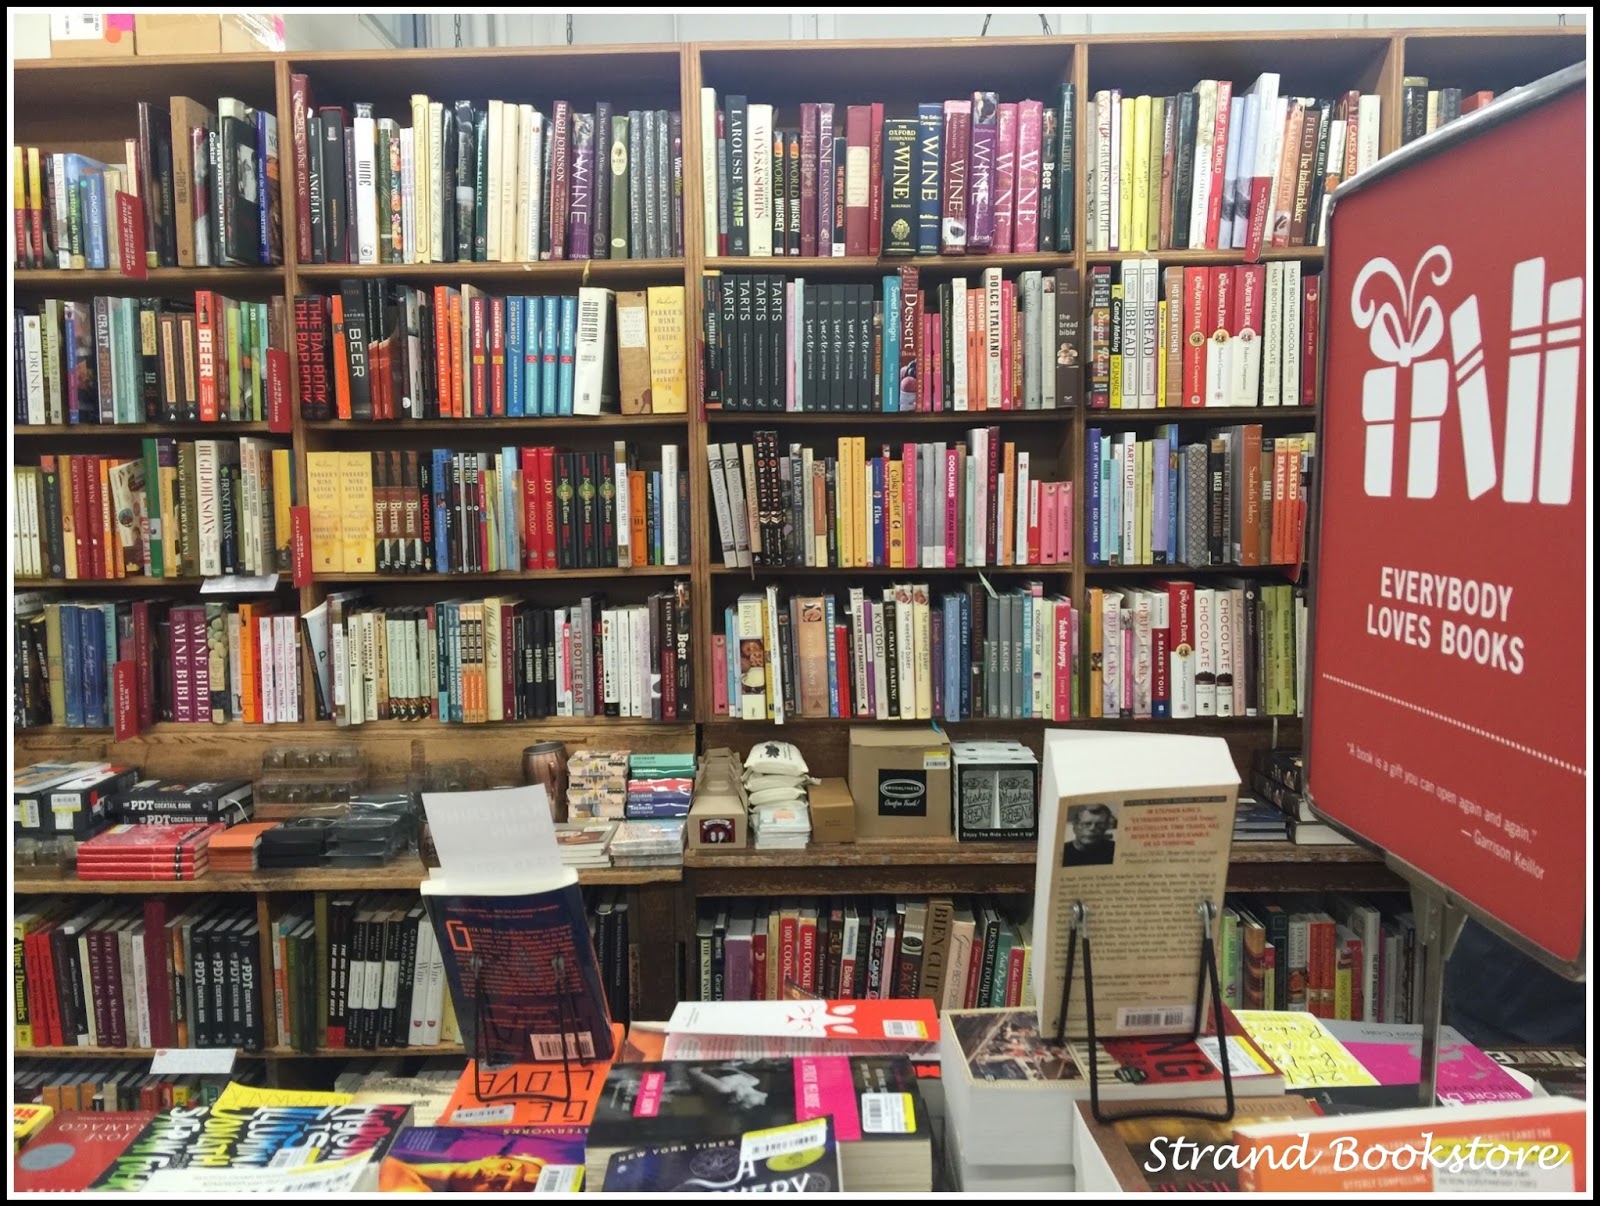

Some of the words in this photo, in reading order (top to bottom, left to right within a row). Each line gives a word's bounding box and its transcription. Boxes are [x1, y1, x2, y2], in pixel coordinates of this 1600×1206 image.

[731, 110, 743, 184] LAROUSSE
[1305, 117, 1315, 148] FIELD
[1349, 125, 1358, 152] CAKES
[774, 159, 783, 196] WORLD
[789, 159, 799, 197] WORLD
[893, 146, 910, 199] WINE
[921, 136, 940, 201] WINE
[971, 138, 990, 205] WINE
[1042, 162, 1055, 189] Beer
[1348, 154, 1357, 174] AND
[571, 156, 588, 224] WINE
[949, 160, 964, 212] WINE
[994, 152, 1014, 226] WINE
[1017, 151, 1038, 226] WINE
[733, 188, 743, 227] WINE
[774, 198, 785, 232] WHISKEY
[790, 199, 800, 233] WHISKEY
[1098, 200, 1109, 232] RALPH
[1295, 198, 1308, 222] Baker
[123, 227, 132, 271] OVERSIZE
[126, 204, 136, 266] BEER/SPIRITS
[724, 280, 735, 321] TARTS
[740, 280, 750, 321] TARTS
[756, 280, 766, 321] TARTS
[772, 281, 782, 321] TARTS
[889, 287, 900, 310] Sweet
[990, 275, 999, 307] DOLCE
[97, 314, 109, 348] CRAFT
[309, 301, 322, 330] THE
[581, 302, 599, 343] BORDEAUX
[888, 311, 899, 342] Designs
[904, 293, 917, 349] Dessert
[990, 310, 999, 358] ITALIANO
[1094, 311, 1109, 344] Sugar
[1125, 309, 1136, 356] BREAD
[1143, 309, 1155, 356] BREAD
[199, 329, 212, 377] BEER
[310, 332, 324, 362] BAR
[349, 328, 365, 377] BEER
[1111, 325, 1120, 352] Making
[1269, 325, 1277, 365] CHOCOLATE
[29, 351, 40, 393] DRINK
[1097, 348, 1109, 377] Rush
[312, 364, 327, 404] BOOK
[527, 480, 536, 495] JOY
[544, 480, 552, 495] JOY
[1214, 472, 1222, 491] BAKED
[1263, 480, 1271, 500] BAKED
[1277, 455, 1285, 500] BAKED
[1289, 455, 1297, 500] BAKED
[422, 495, 431, 543] UNCORKED
[528, 502, 537, 536] MIXOLOGY
[1380, 566, 1513, 622] EVERYBODY
[174, 623, 188, 665] WINE
[194, 623, 207, 665] WINE
[573, 631, 581, 640] 12
[677, 633, 688, 660] Beer
[875, 613, 884, 658] KYOTOFU
[1199, 597, 1210, 668] CHOCOLATE
[1220, 598, 1230, 669] CHOCOLATE
[1367, 604, 1431, 649] LOVES
[1441, 620, 1525, 675] BOOKS
[319, 651, 326, 662] P
[573, 642, 582, 681] BOTTLE
[1002, 641, 1010, 672] BAKING
[176, 670, 190, 715] BIBLE
[195, 670, 209, 715] BIBLE
[575, 683, 583, 704] BAR
[130, 801, 154, 810] PDT
[1356, 747, 1373, 764] book
[1375, 756, 1382, 768] is
[1389, 763, 1403, 781] gift
[1403, 770, 1418, 787] you
[1420, 778, 1435, 794] can
[1437, 782, 1457, 806] open
[1459, 793, 1482, 814] again
[1484, 807, 1501, 828] and
[147, 815, 170, 824] PDT
[1474, 830, 1511, 862] Garrison
[1514, 854, 1545, 880] Keillor
[930, 907, 949, 946] BIEN
[194, 961, 206, 986] PDT
[212, 960, 224, 985] PDT
[230, 960, 239, 984] PDT
[242, 964, 253, 989] PDT
[802, 949, 811, 988] COOKIE
[925, 951, 942, 992] CUIT
[467, 1070, 594, 1095] LOVE
[618, 1151, 646, 1162] NEW
[654, 1144, 687, 1155] YORK
[695, 1140, 735, 1150] TIMES
